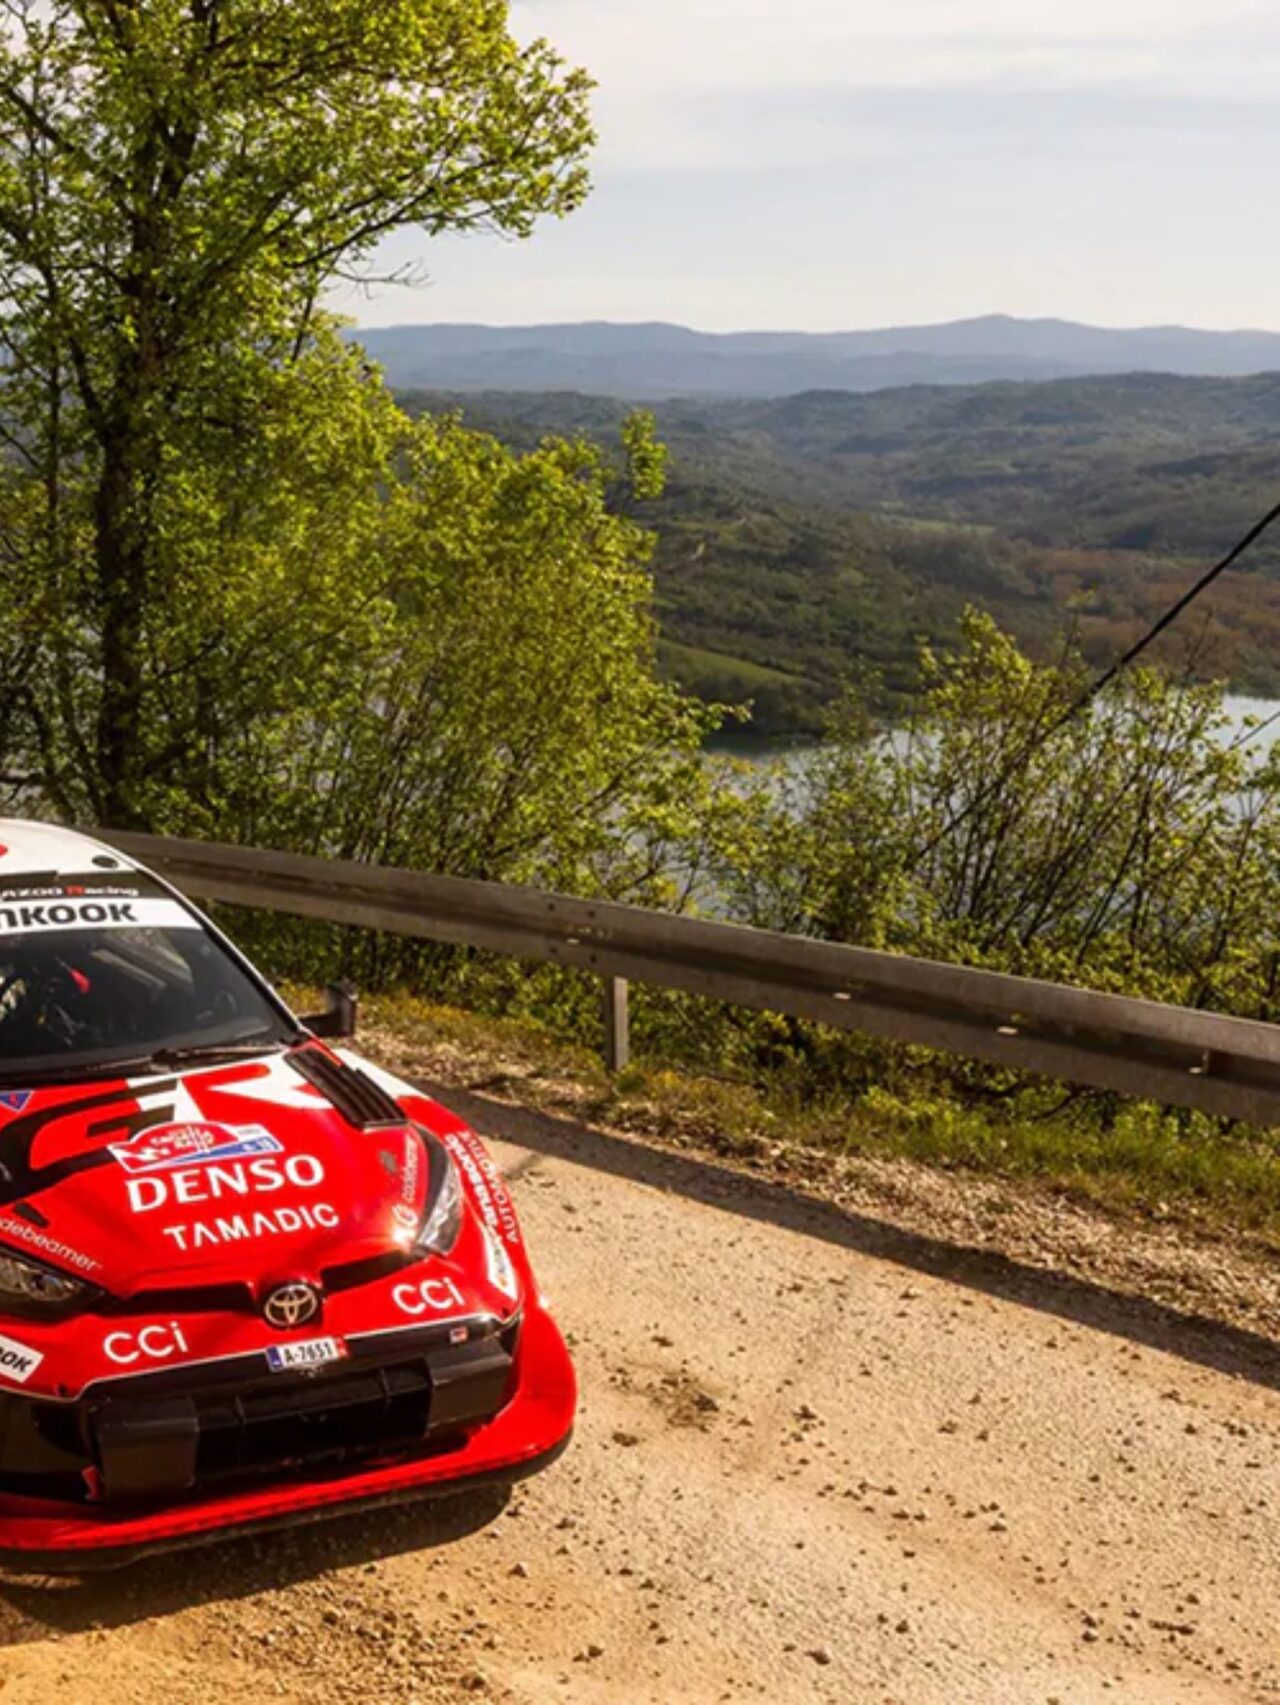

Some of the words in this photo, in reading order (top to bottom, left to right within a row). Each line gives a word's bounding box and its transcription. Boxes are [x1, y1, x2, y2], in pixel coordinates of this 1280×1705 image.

[126, 1154, 325, 1213] DENSO
[163, 1203, 340, 1251] TAMADIC
[393, 1277, 464, 1314] CCi
[103, 1322, 188, 1364] CCi
